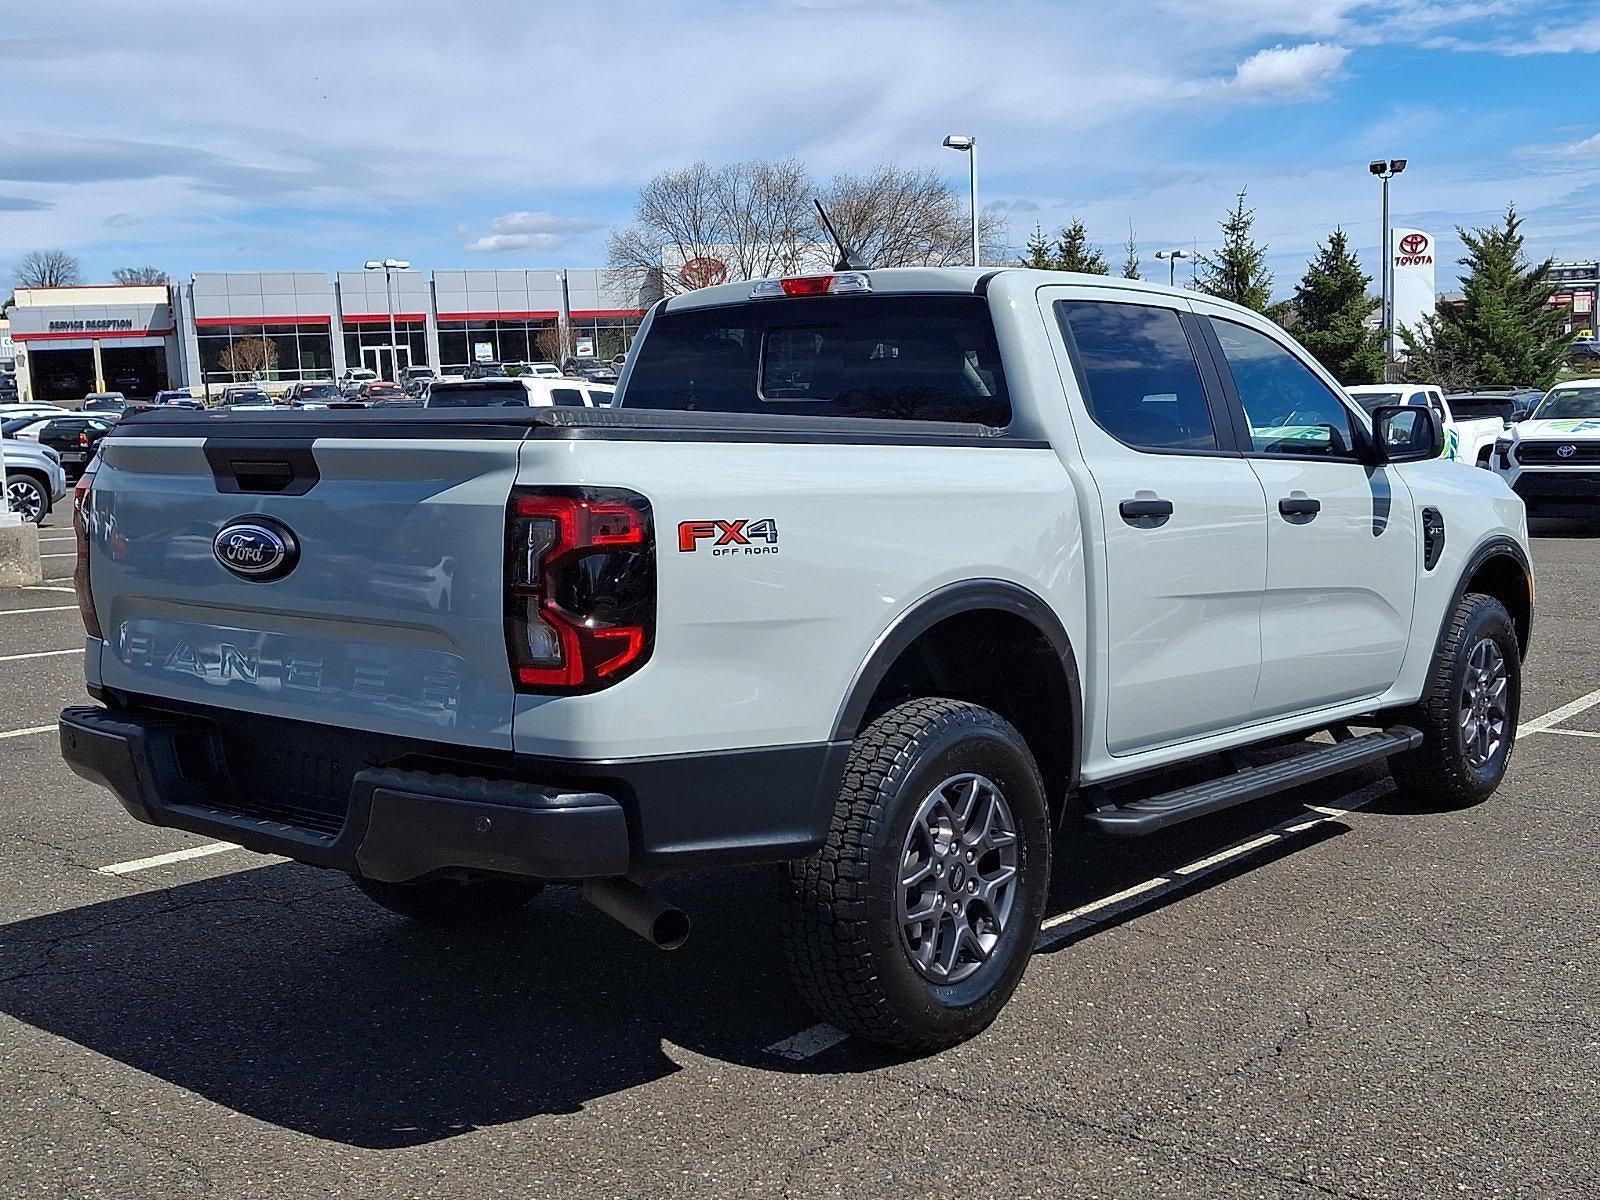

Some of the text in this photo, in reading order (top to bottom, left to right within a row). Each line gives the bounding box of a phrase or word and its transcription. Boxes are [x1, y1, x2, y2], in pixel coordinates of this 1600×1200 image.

[1394, 255, 1433, 267] TOYOTA
[49, 318, 133, 330] SERVICE RECEPTION
[678, 519, 778, 552] FX4
[226, 534, 265, 562] Ford
[712, 546, 779, 556] OFF ROAD
